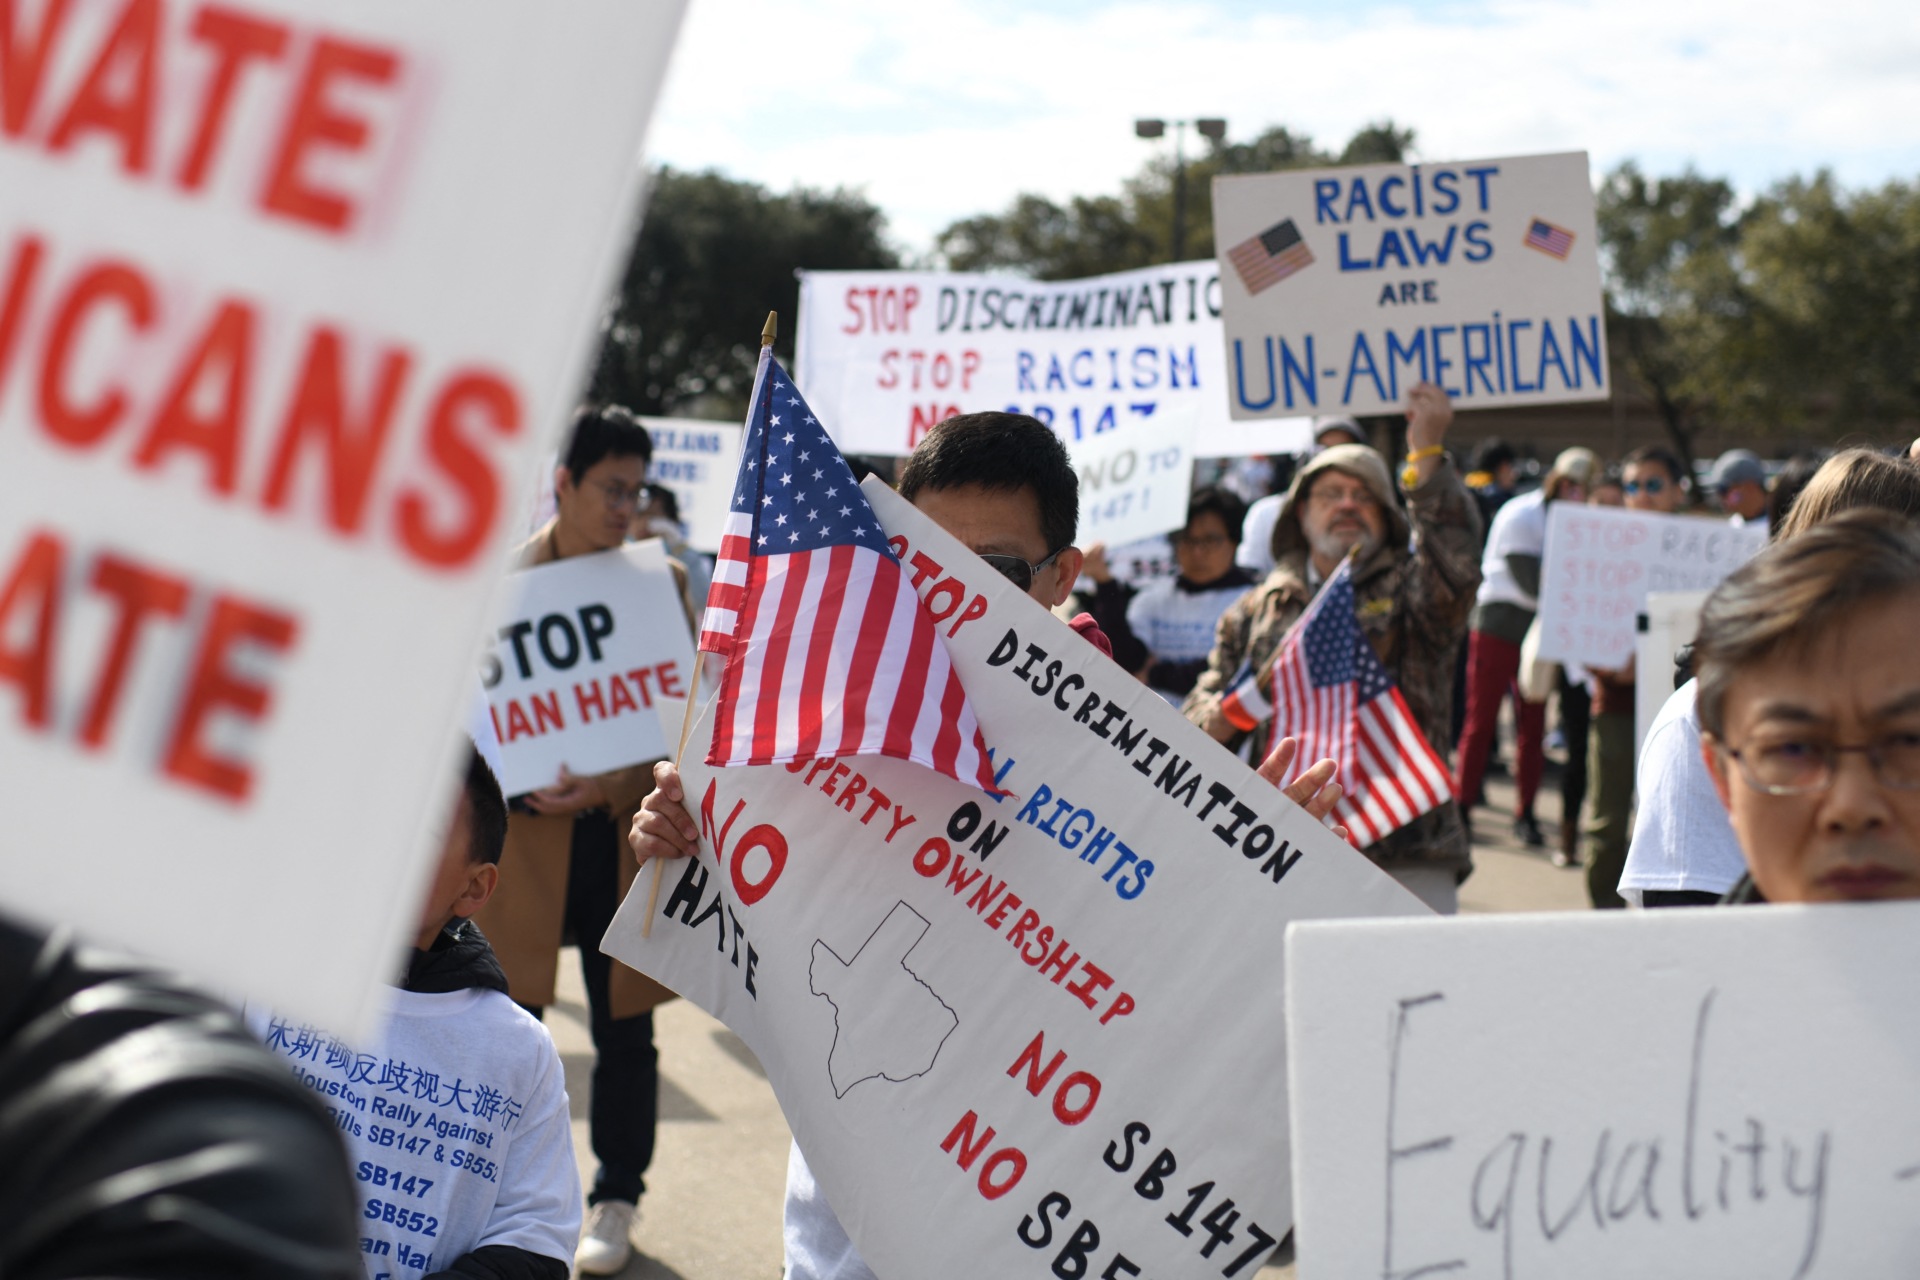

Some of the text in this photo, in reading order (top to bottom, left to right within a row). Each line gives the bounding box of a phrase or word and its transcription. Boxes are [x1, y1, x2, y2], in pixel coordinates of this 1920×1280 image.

[1315, 165, 1499, 224] RACIST
[1338, 221, 1494, 272] LAWS
[841, 285, 920, 335] STOP
[1378, 280, 1438, 307] ARE
[878, 345, 1202, 392] STOP RACISM
[1234, 311, 1603, 412] UN-AMERICAN
[907, 403, 962, 450] N
[1079, 446, 1182, 493] NO TO
[1565, 518, 1649, 553] STOP
[1562, 556, 1645, 590] STOP
[1558, 590, 1635, 621] STOP
[1555, 622, 1634, 655] STOP
[572, 660, 687, 726] HATE
[986, 627, 1304, 885] DISCRIMINATION
[700, 776, 789, 907] NO
[945, 801, 1010, 862] ON
[1015, 782, 1155, 901] RIGHTS
[662, 855, 760, 1002] HATE
[912, 836, 1136, 1026] OWNERSHIP
[367, 1124, 432, 1157] SB147
[434, 1144, 446, 1164] &
[371, 1096, 422, 1129] Rally
[423, 1111, 494, 1150] Against
[1380, 986, 1830, 1280] Equality
[355, 1160, 435, 1199] SB147
[939, 1109, 1028, 1201] NO
[1005, 1030, 1277, 1278] NO SB147
[363, 1199, 440, 1238] SB552
